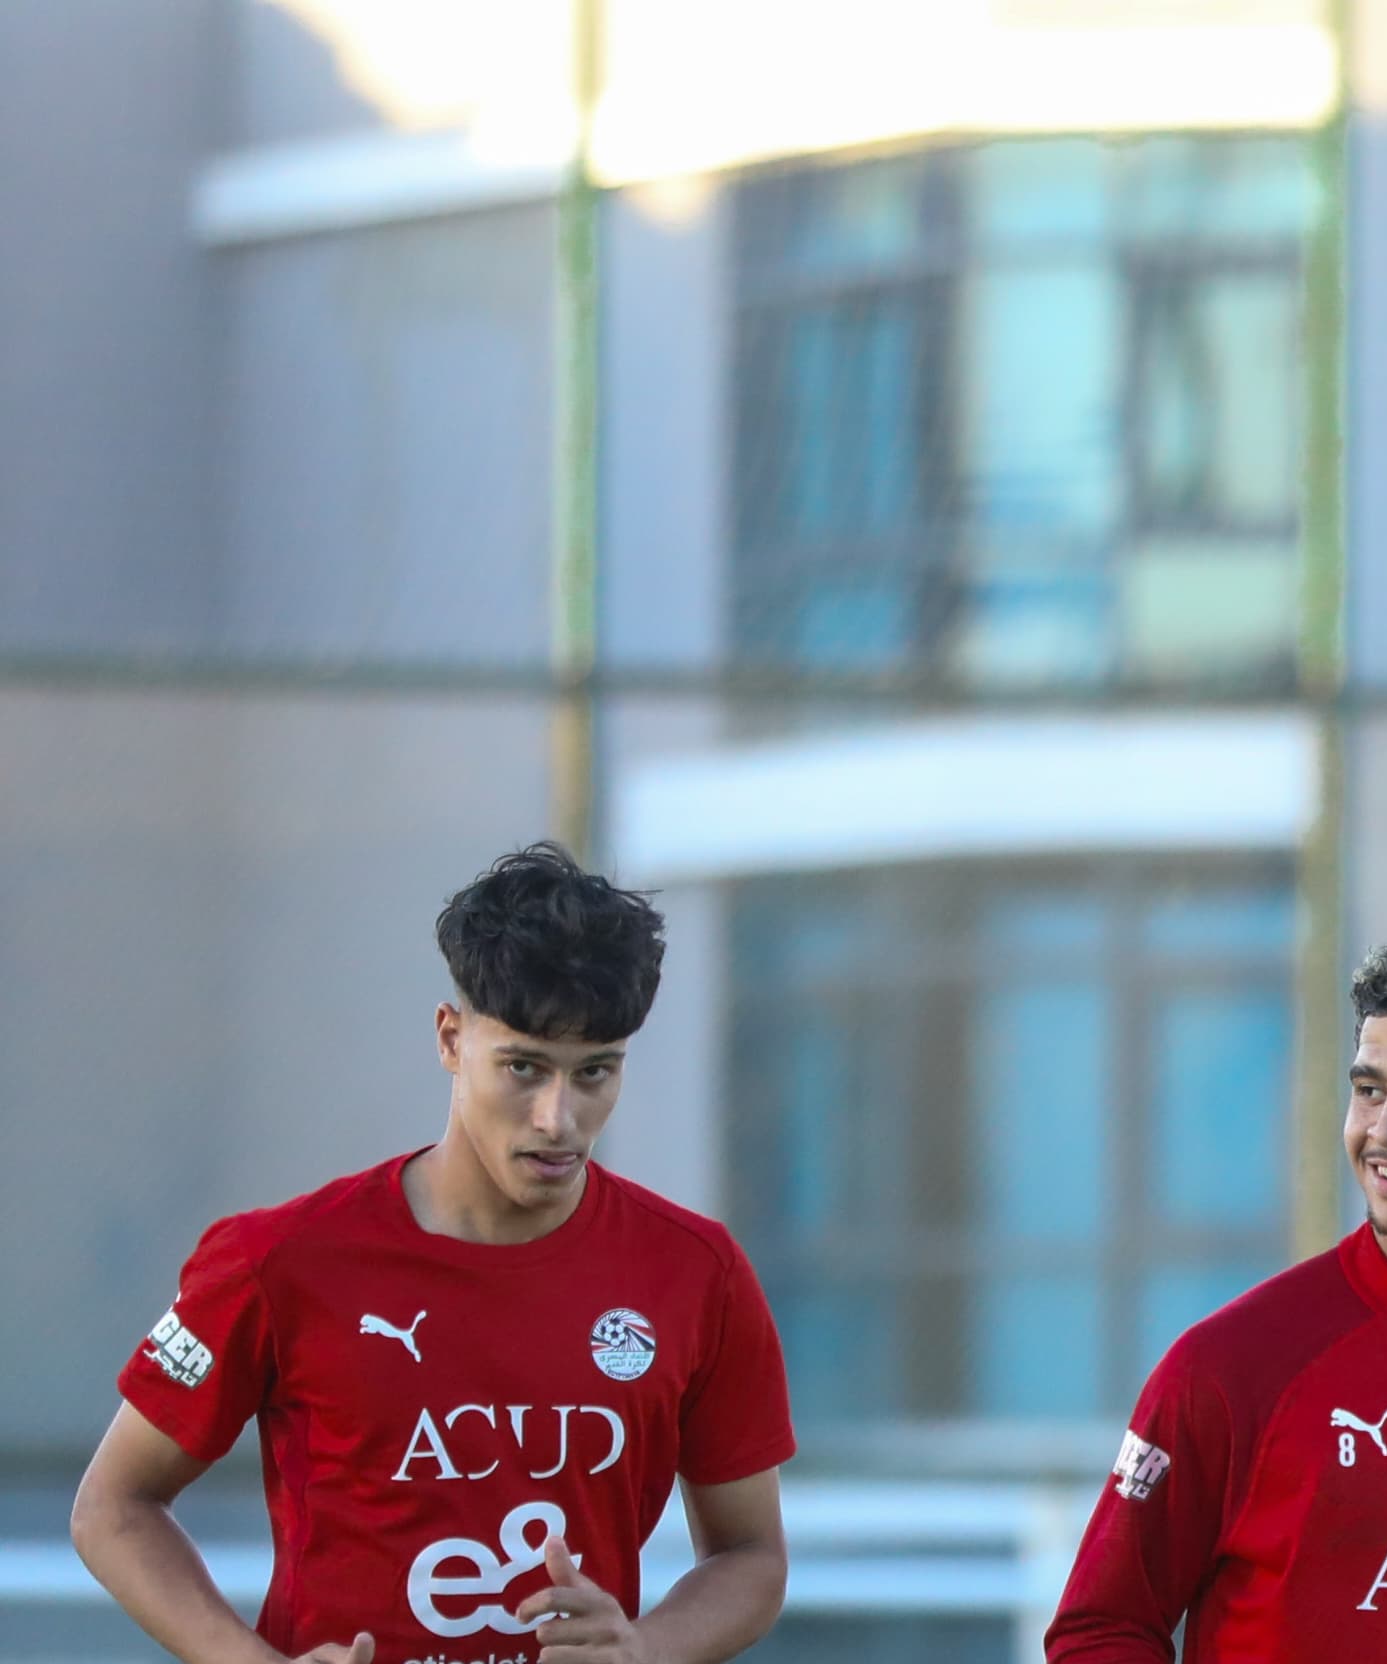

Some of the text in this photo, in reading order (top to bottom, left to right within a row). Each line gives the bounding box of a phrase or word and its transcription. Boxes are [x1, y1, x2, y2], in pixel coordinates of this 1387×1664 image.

[149, 1308, 214, 1379] GER
[391, 1403, 625, 1482] ACUD
[1338, 1432, 1356, 1468] 8
[406, 1500, 583, 1638] e&
